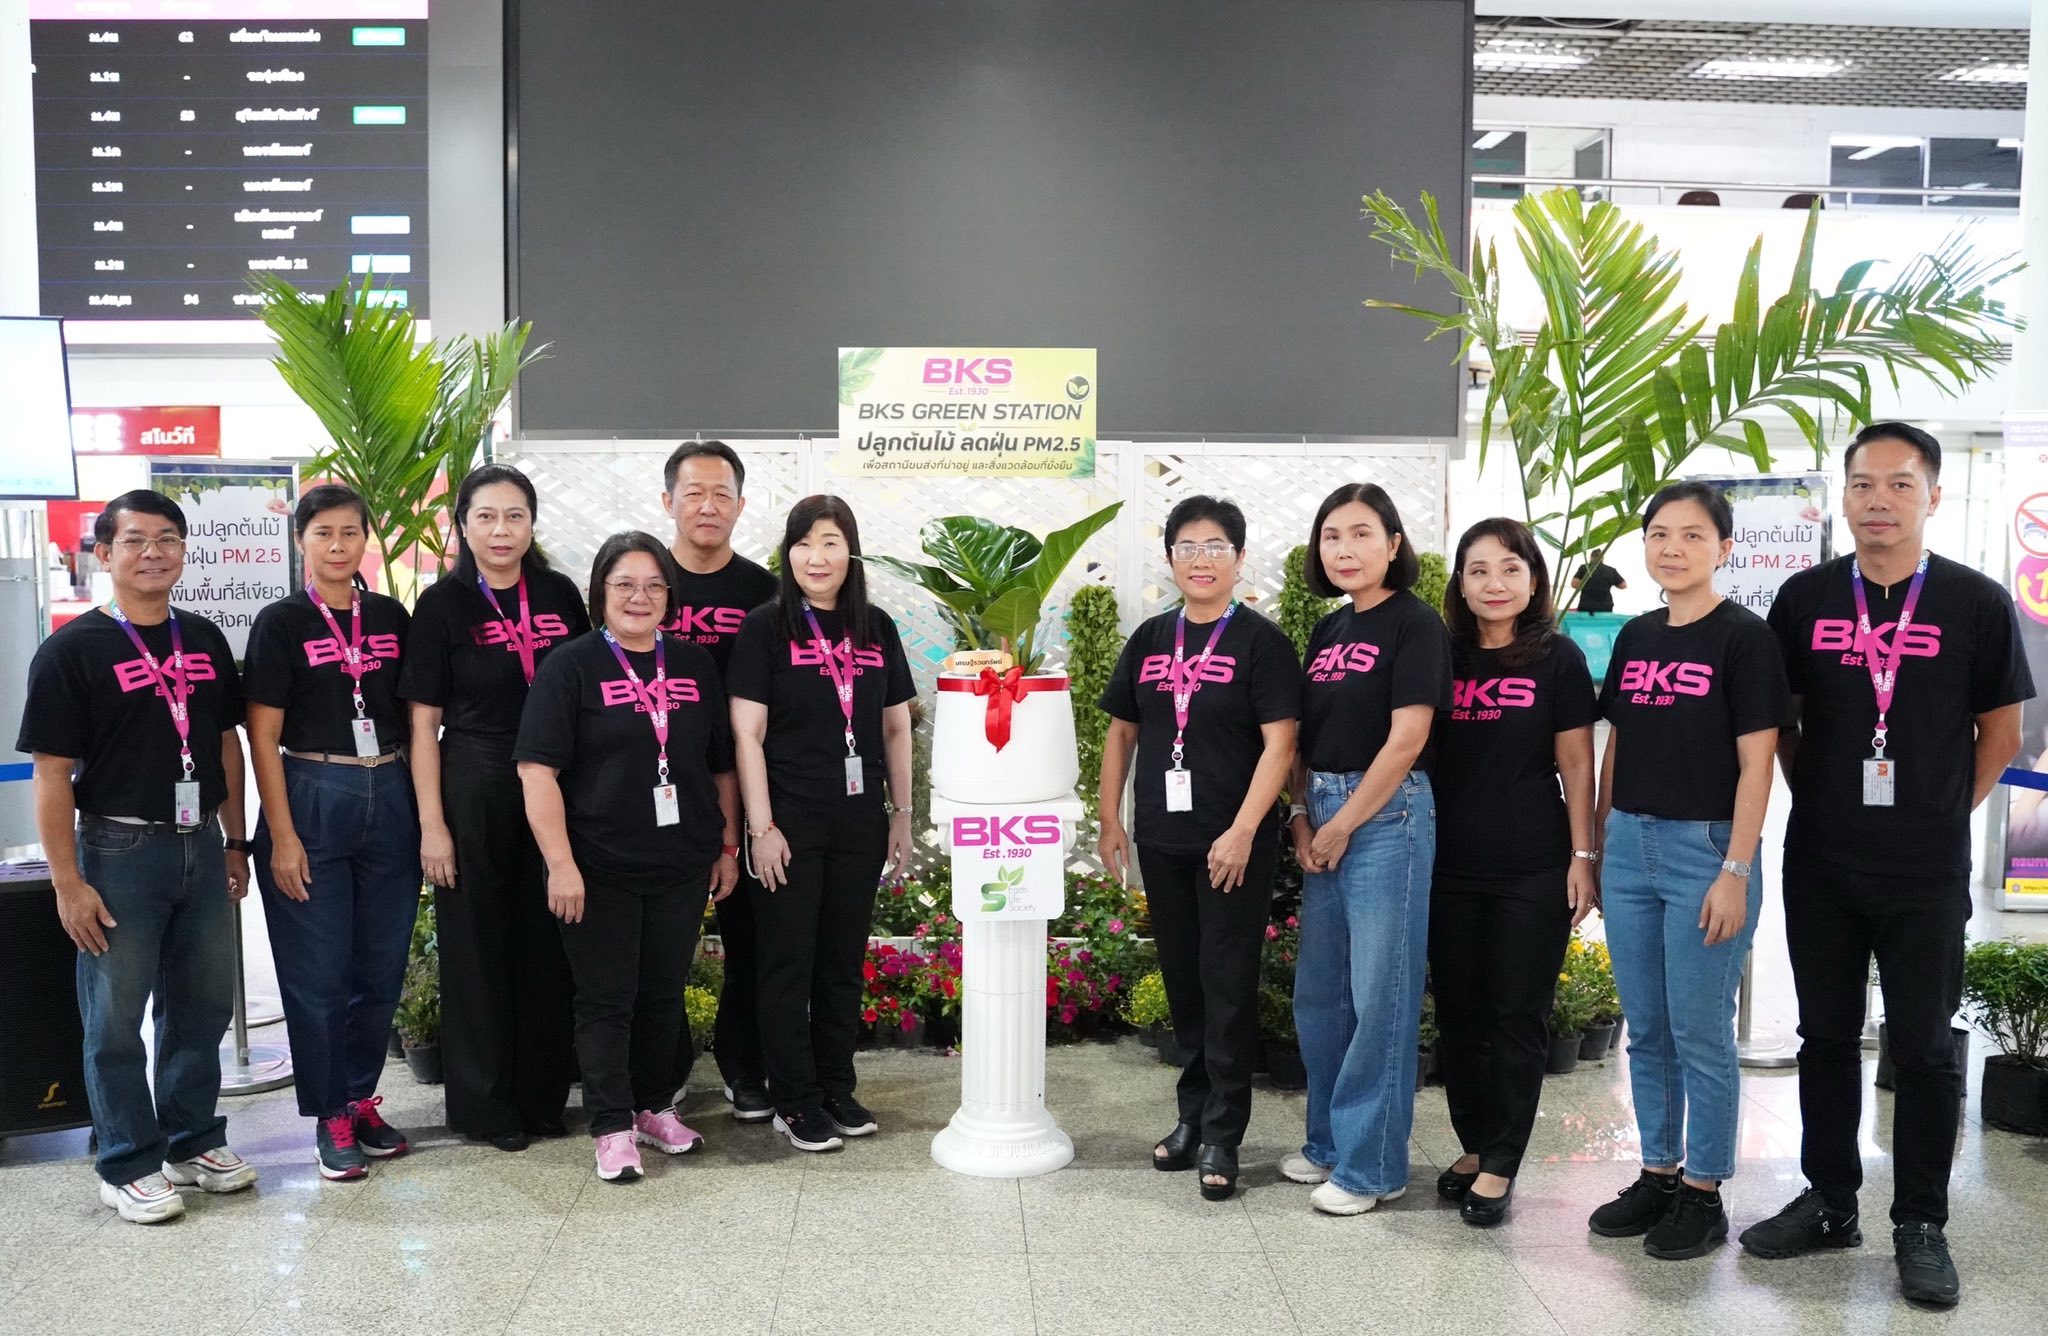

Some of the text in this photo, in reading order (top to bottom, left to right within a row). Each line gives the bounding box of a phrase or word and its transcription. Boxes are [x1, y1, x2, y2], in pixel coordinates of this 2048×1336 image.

[923, 358, 1013, 384] BKS
[858, 403, 1082, 420] BKS GREEN STATION
[857, 430, 1081, 458] ปลูกต้นไม้ ลดฝุ่น PM2.5
[862, 460, 970, 473] เพื่อสถานีขนส่งที่น่าอยู่
[223, 549, 250, 564] PM
[256, 548, 282, 564] 2.5
[1752, 554, 1780, 569] PM
[1785, 554, 1812, 569] 2.5
[169, 577, 285, 602] พิ่มพื้นที่สีเขียว
[303, 633, 400, 668] BS
[1307, 642, 1380, 675] BKS
[1139, 654, 1236, 684] BKS
[1621, 660, 1714, 697] BKS
[953, 815, 1060, 847] BKS
